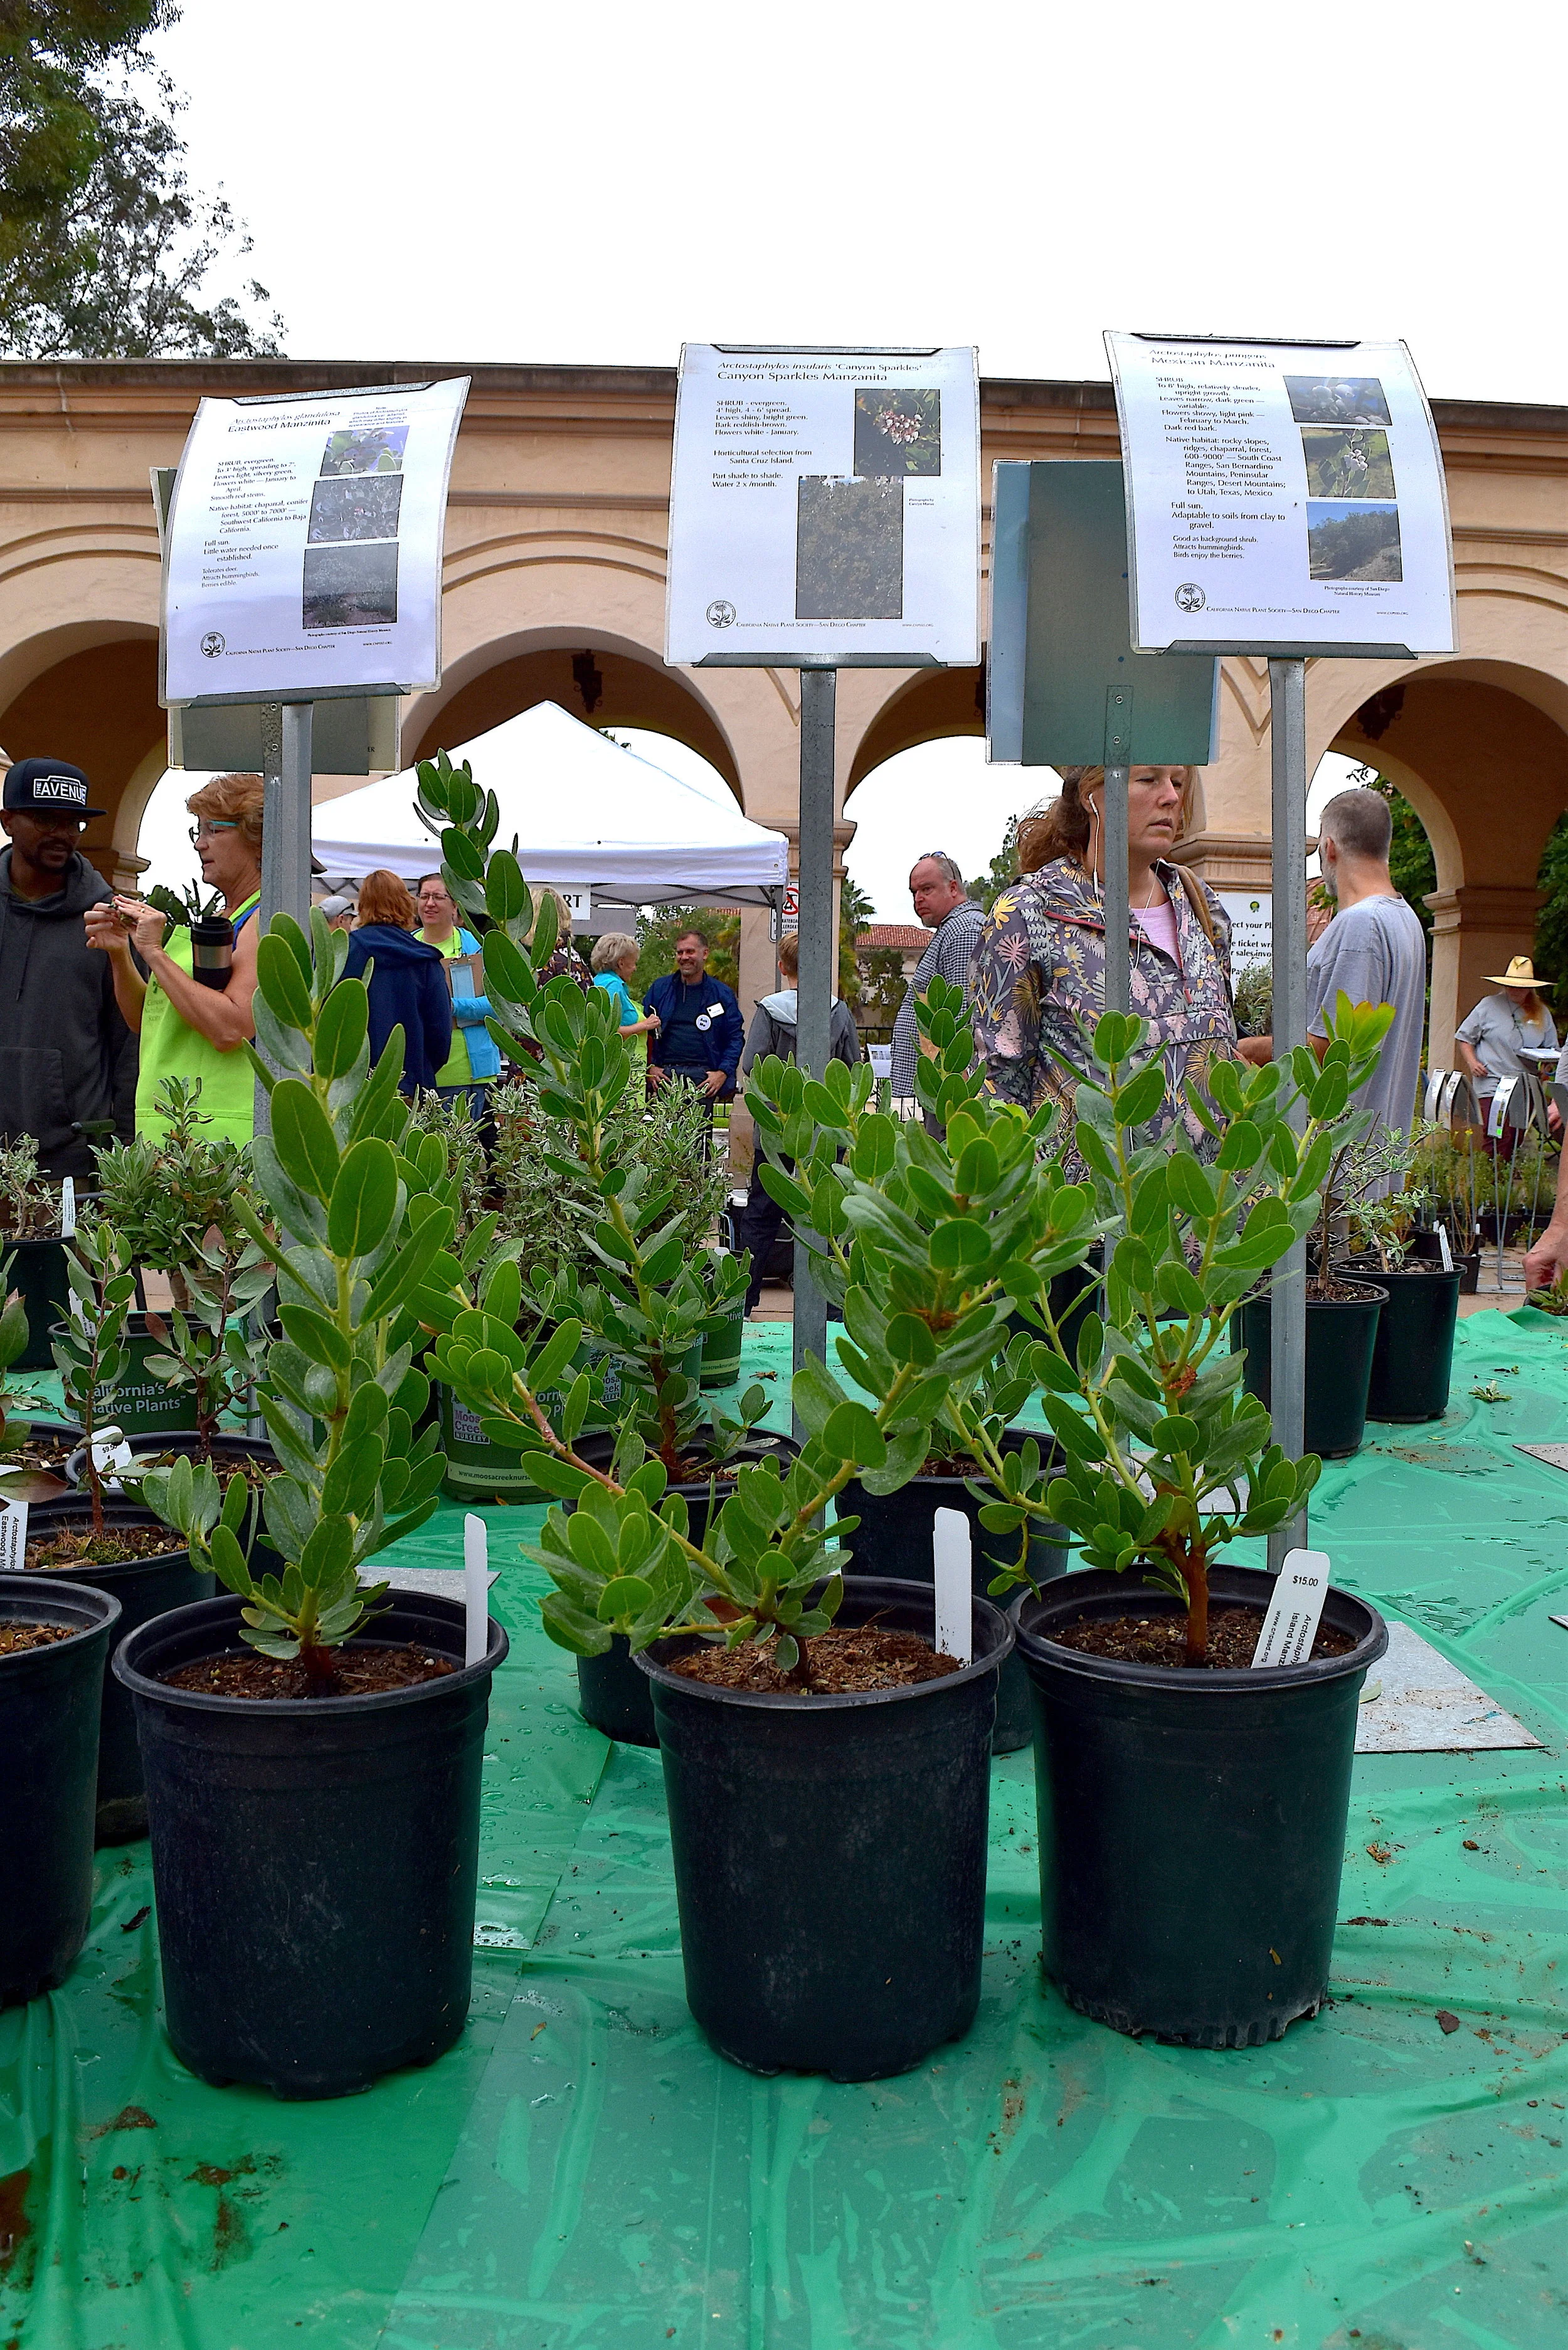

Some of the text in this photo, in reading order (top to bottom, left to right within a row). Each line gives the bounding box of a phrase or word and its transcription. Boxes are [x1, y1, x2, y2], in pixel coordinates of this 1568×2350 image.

[718, 362, 789, 370] Arctostaphylos
[1210, 360, 1274, 368] Manzanita
[718, 372, 887, 381] Canyon Sparkles Manzanita
[294, 410, 341, 420] glandulosa
[228, 418, 331, 432] Eastwood Manzinita
[1210, 445, 1247, 453] chaparral,
[1187, 479, 1216, 487] Ranges,
[253, 515, 282, 523] California
[1172, 511, 1210, 519] Adaptable
[1261, 513, 1275, 522] clay
[1189, 522, 1214, 530] gravel.
[217, 554, 252, 562] established.
[41, 782, 86, 802] AVENUE
[85, 1382, 164, 1397] alifornia's
[455, 1410, 483, 1422] Moos
[455, 1421, 483, 1434] Cree
[455, 1432, 487, 1442] NURSERY
[0, 1516, 9, 1569] Eastwood's M
[1293, 1575, 1318, 1587] $15.00
[1261, 1611, 1281, 1663] www.cnpssd.org
[1278, 1612, 1300, 1666] Island Manz
